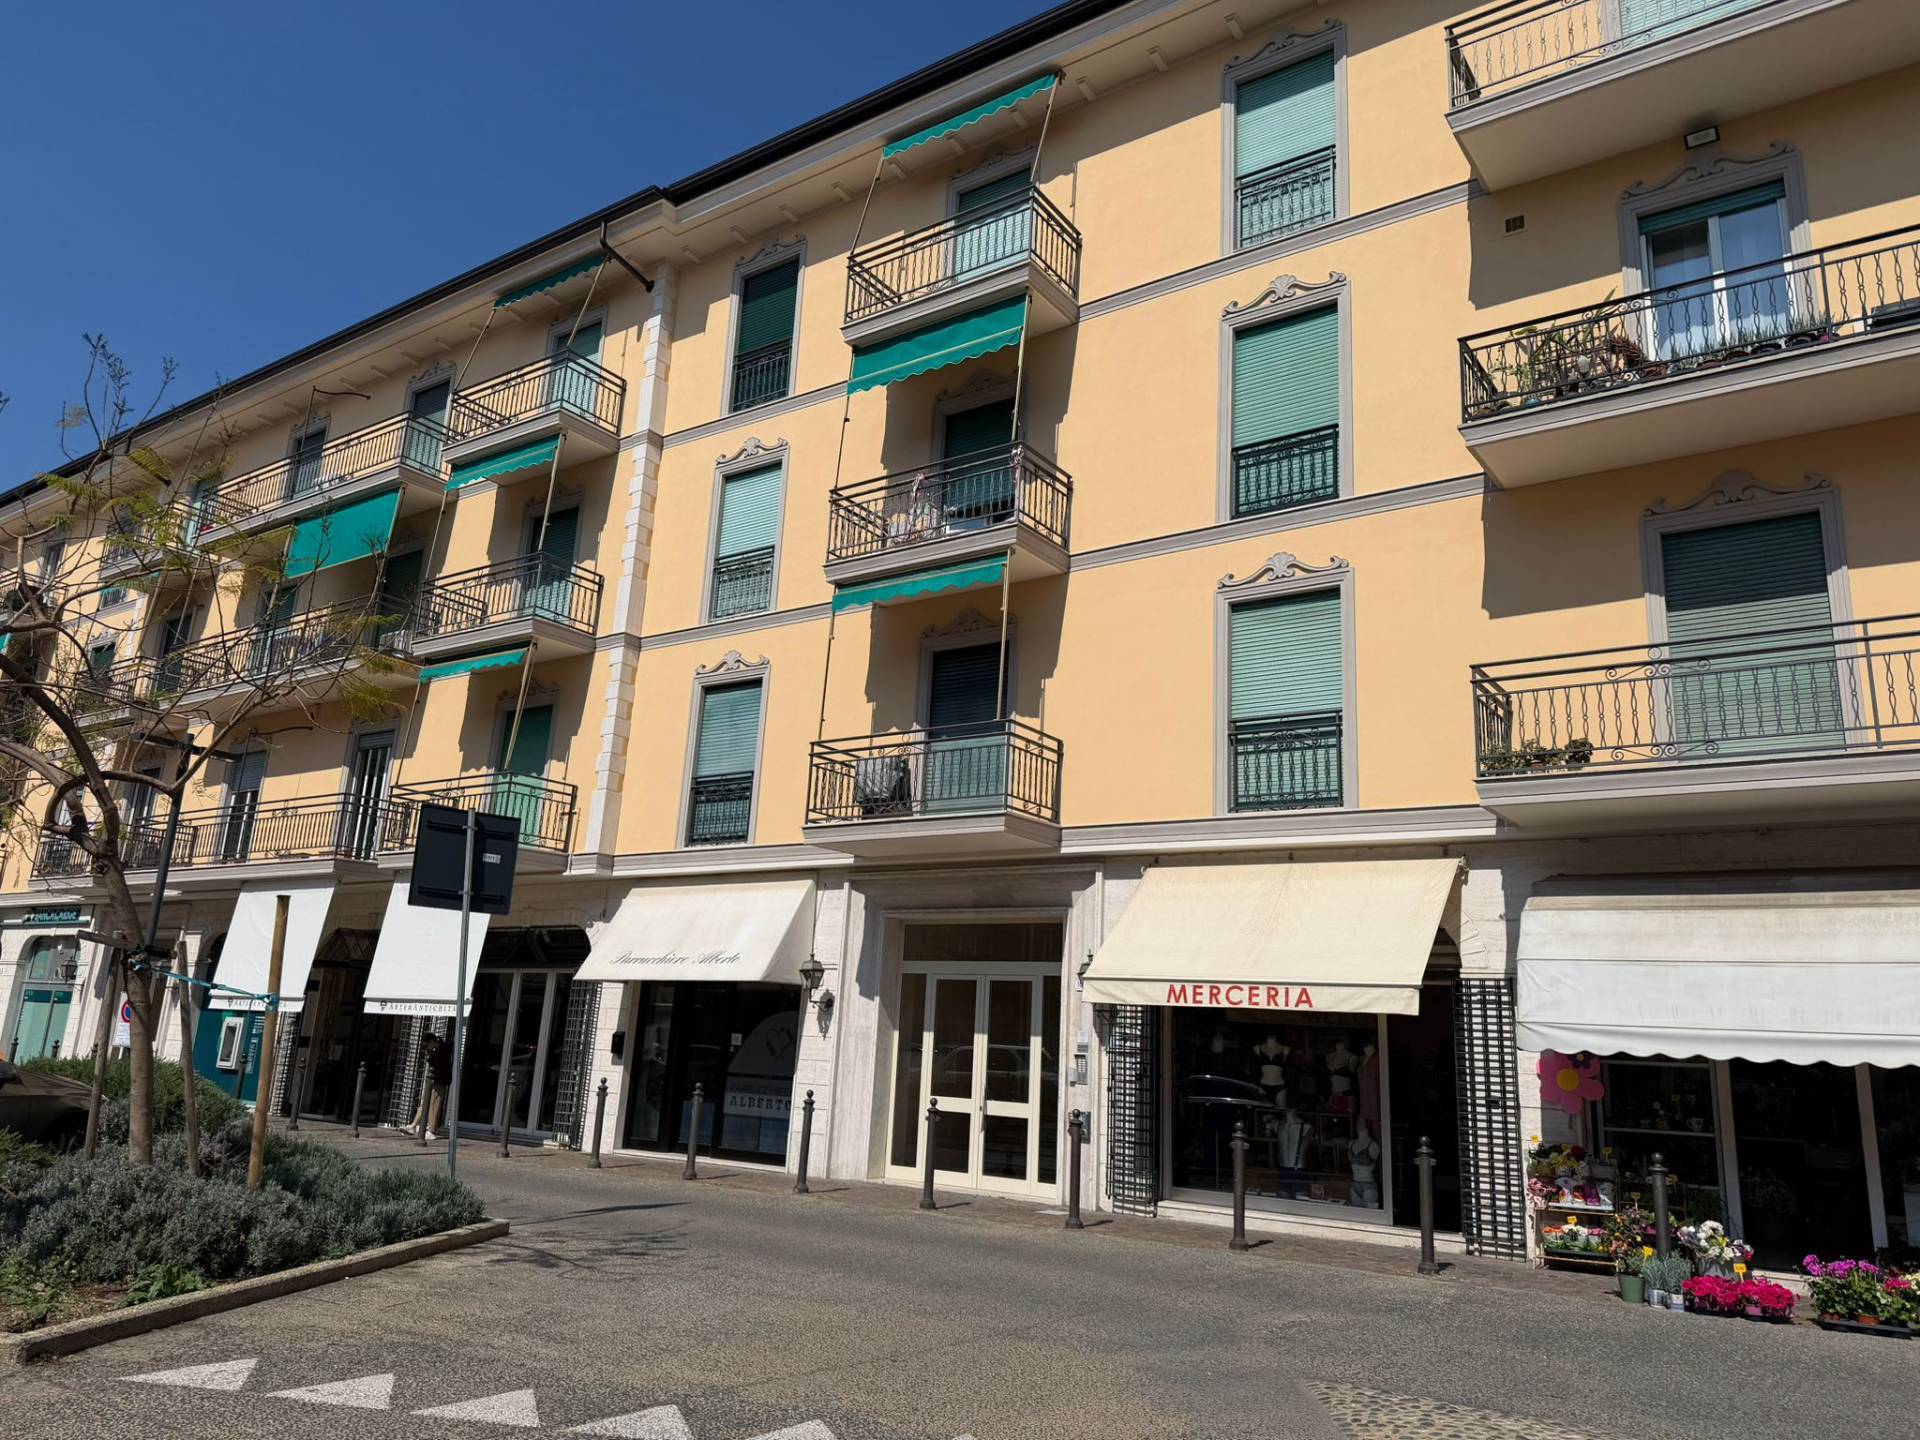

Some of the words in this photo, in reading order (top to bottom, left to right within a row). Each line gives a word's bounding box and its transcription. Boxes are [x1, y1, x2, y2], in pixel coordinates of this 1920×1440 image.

[610, 950, 689, 966] Parrucchiere
[692, 950, 740, 966] Alberto
[1167, 984, 1313, 1008] MERCERIA
[730, 1096, 791, 1112] ALBERTO
